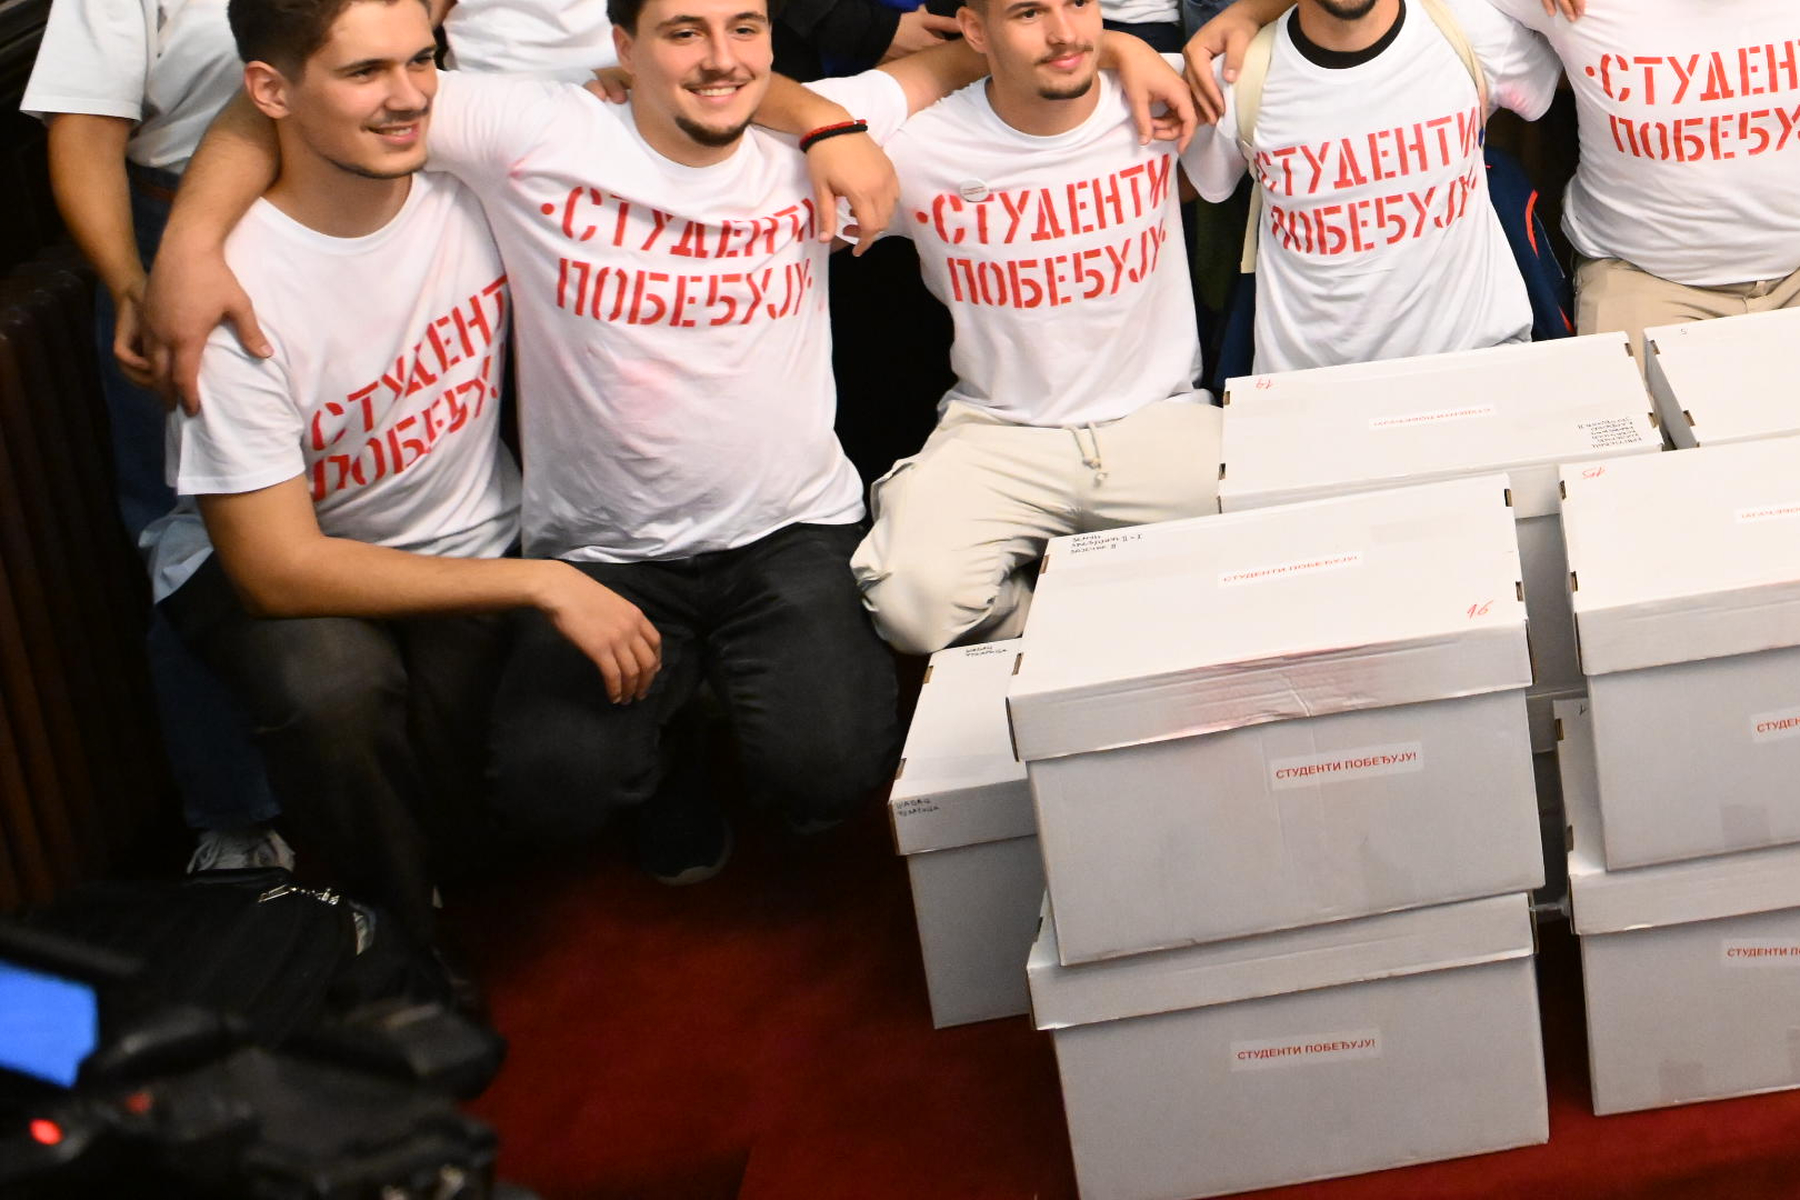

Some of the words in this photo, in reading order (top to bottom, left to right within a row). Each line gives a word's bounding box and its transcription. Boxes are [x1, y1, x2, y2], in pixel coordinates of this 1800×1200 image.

[1254, 107, 1477, 197] СТУДЕНТИ
[932, 154, 1171, 246] СТУДЕНТИ
[1276, 762, 1342, 780] СТУДЕНТИ
[1344, 752, 1417, 771] ПОБЕЂУЈУ!
[1727, 946, 1788, 958] СТУДЕНТИ
[1237, 1046, 1302, 1060] СТУДЕНТИ
[1304, 1039, 1376, 1054] ПОБЕЂУЈУ!
